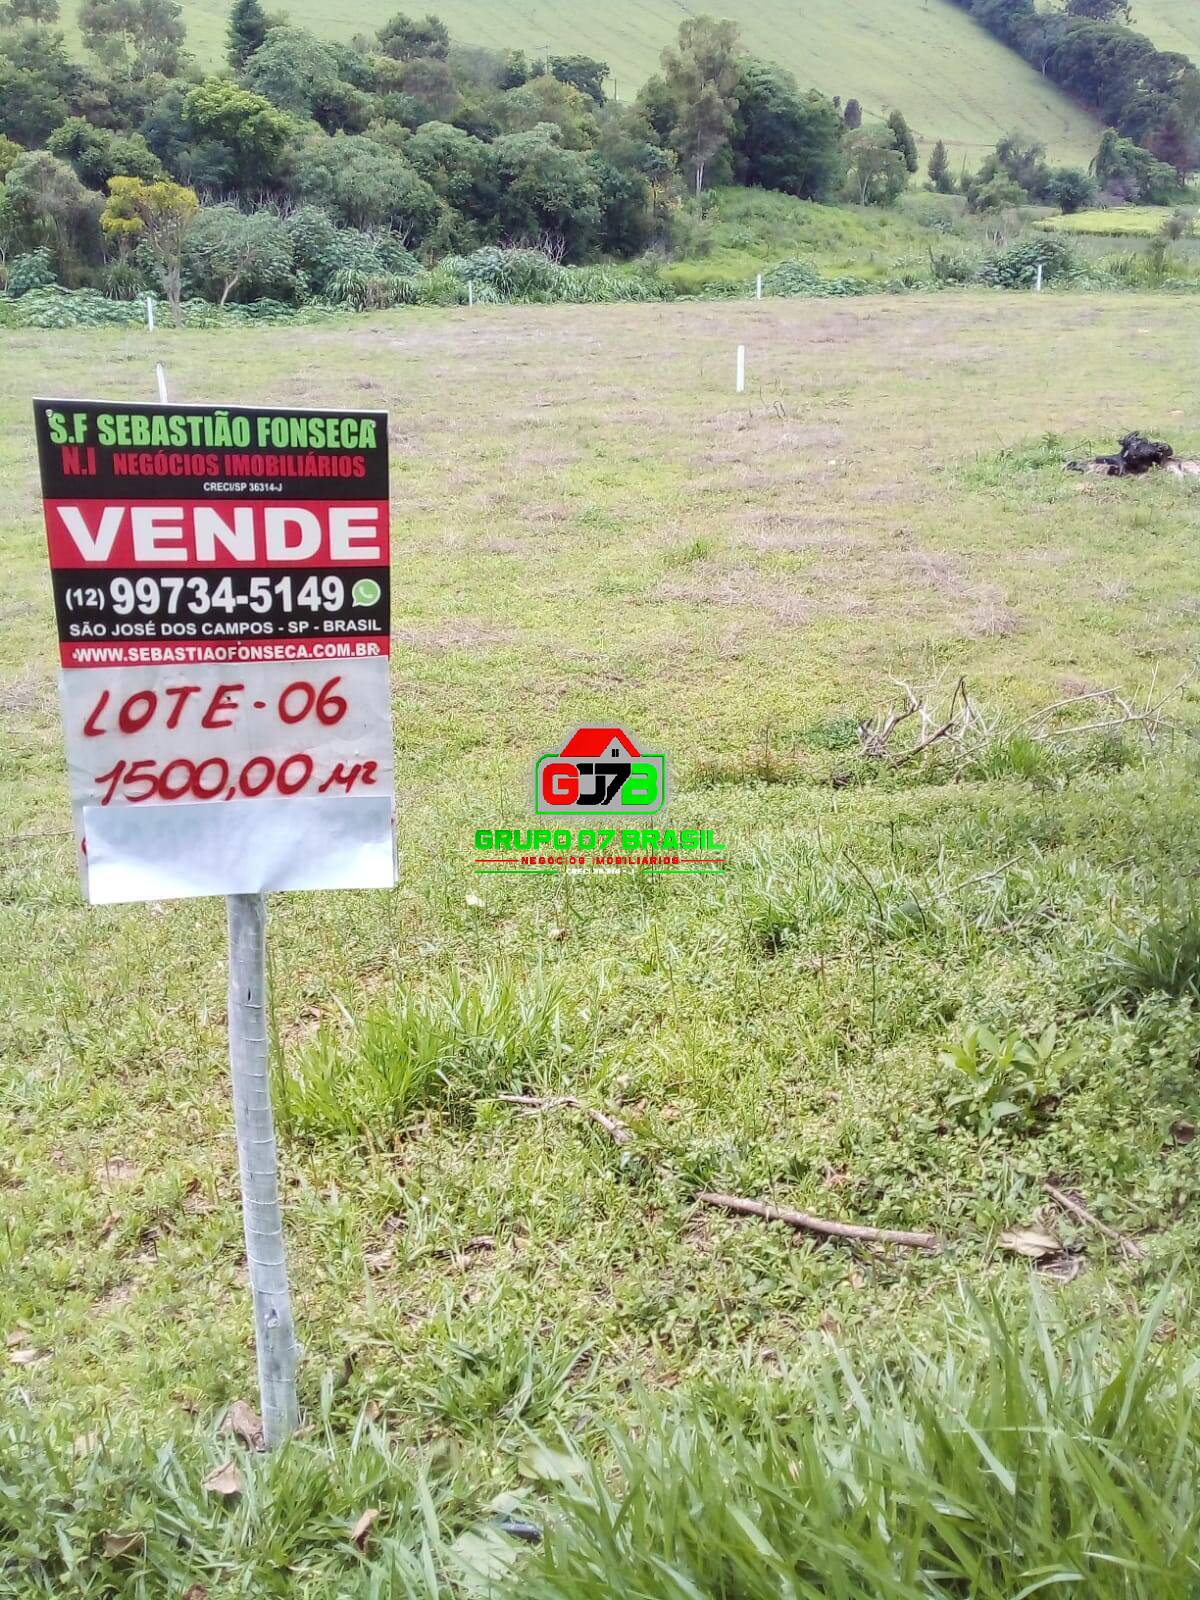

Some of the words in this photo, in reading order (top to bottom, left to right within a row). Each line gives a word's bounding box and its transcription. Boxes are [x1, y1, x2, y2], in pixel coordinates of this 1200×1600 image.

[50, 411, 87, 444] S.F
[96, 410, 250, 448] SEBASTIÃO
[256, 416, 377, 449] FONSECA
[62, 446, 95, 476] N.I
[113, 449, 220, 477] NEGÓCIOS
[224, 451, 366, 478] IMOBILIÁRIOS
[203, 482, 248, 492] CRECI/SP
[56, 506, 382, 562] VENDE
[65, 588, 105, 611] (12)
[110, 575, 345, 615] 99734-5149
[69, 622, 106, 637] SÃO
[111, 619, 156, 636] JOSÉ
[161, 623, 197, 636] DOS
[201, 622, 273, 636] CAMPOS
[288, 621, 310, 633] SP
[323, 619, 382, 633] BRASIL
[76, 643, 379, 662] WWW.SEBASTIAOFONSECA.COM.BR
